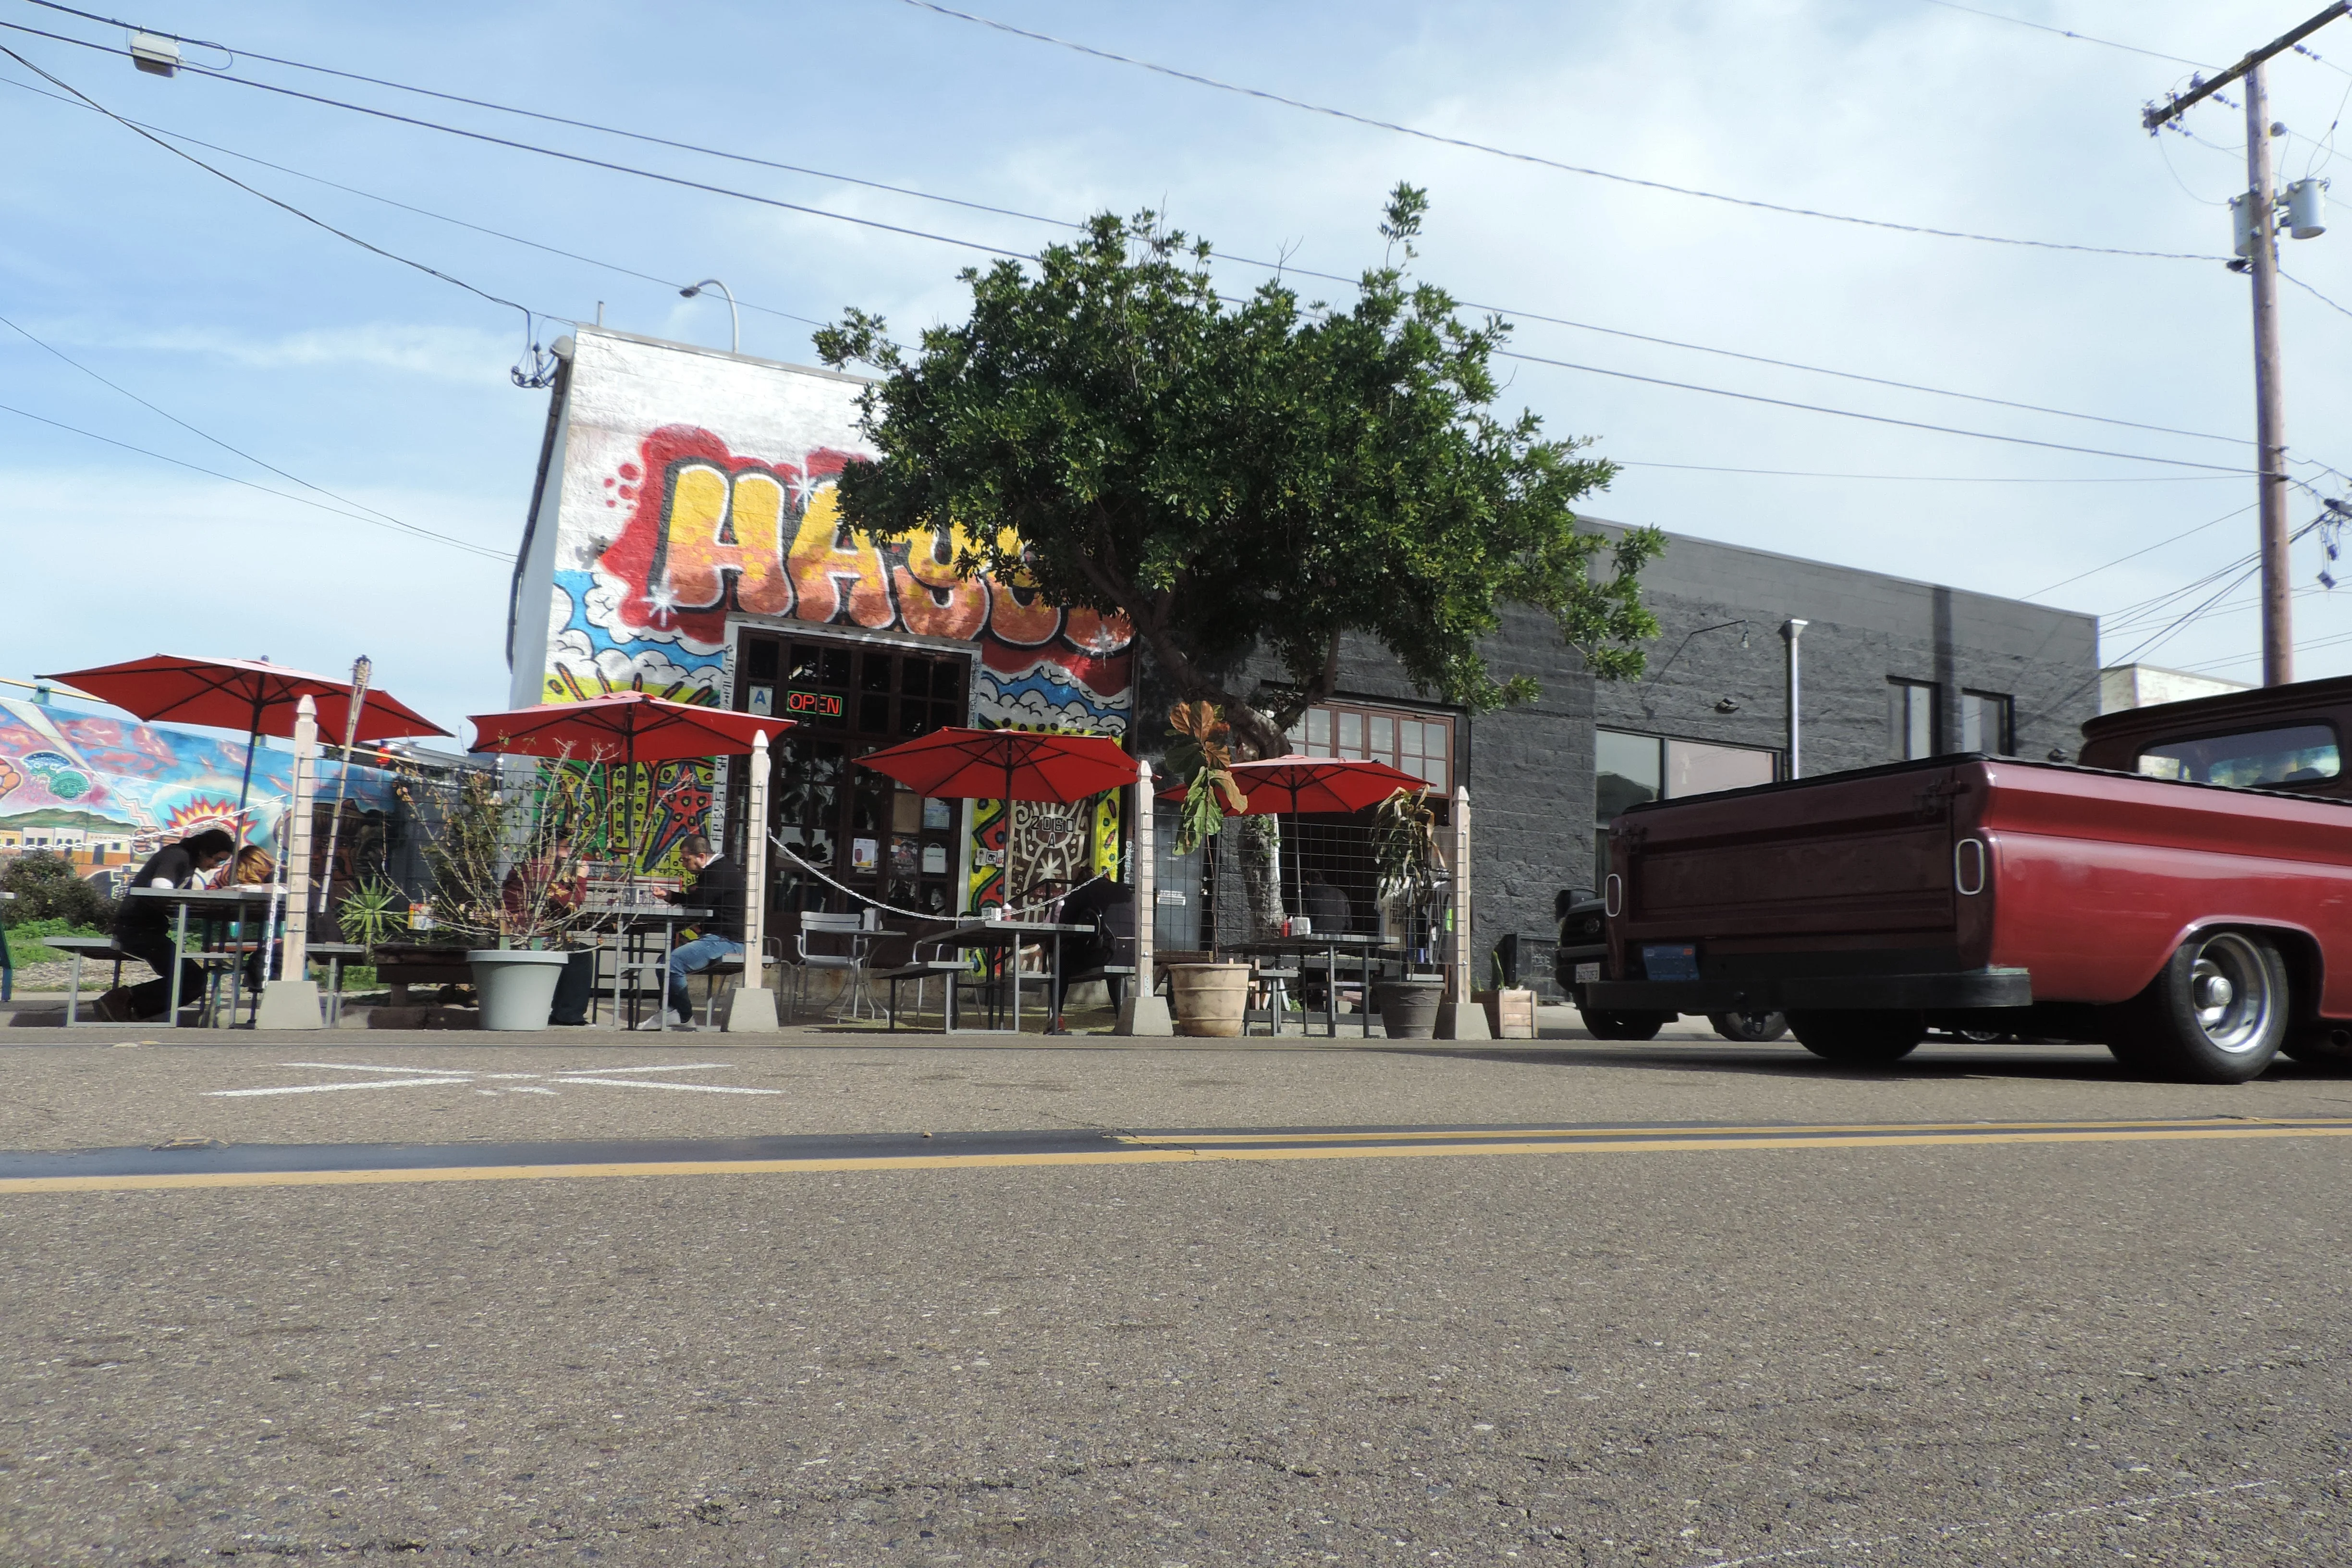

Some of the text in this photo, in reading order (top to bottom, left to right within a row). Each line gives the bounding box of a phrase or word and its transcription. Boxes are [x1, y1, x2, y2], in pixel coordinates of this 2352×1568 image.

[754, 690, 767, 705] A
[789, 693, 840, 714] OPEN
[1030, 815, 1075, 833] 2060
[1047, 832, 1056, 848] A
